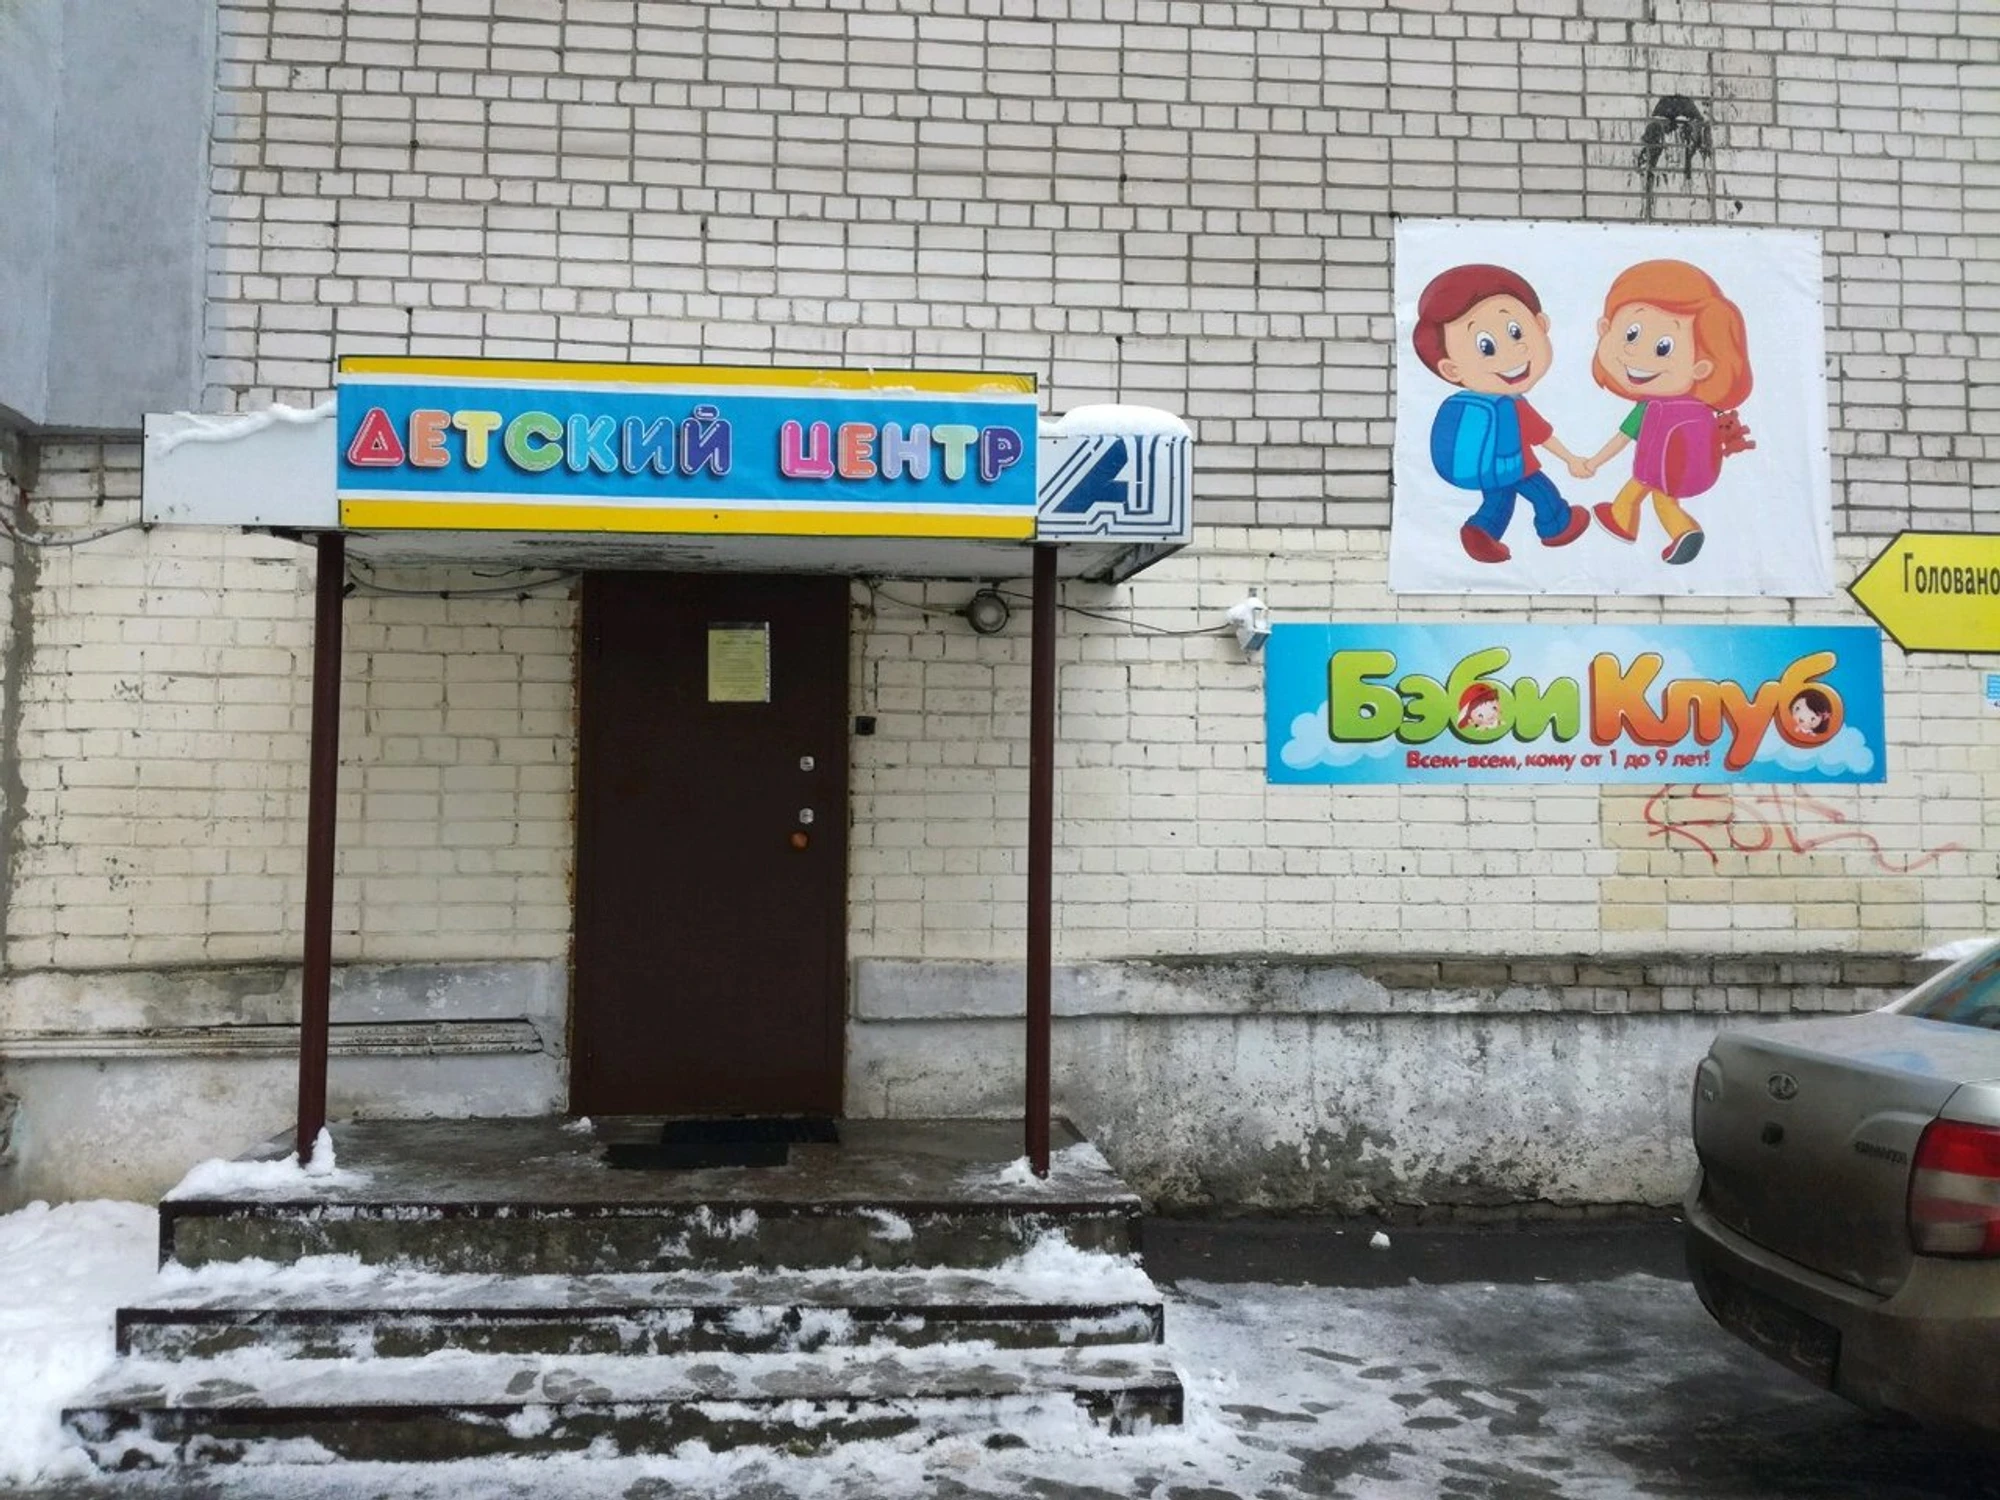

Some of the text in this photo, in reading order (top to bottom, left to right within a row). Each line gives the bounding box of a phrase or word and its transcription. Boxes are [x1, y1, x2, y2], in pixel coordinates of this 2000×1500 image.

[346, 405, 1023, 482] ДЕТСКИЙ ЦЕНТР
[1904, 552, 2000, 595] Головано
[1327, 646, 1844, 772] Бэби Клуб
[1405, 748, 1711, 772] Всем-всем, кому от 1 до 9 лет!
